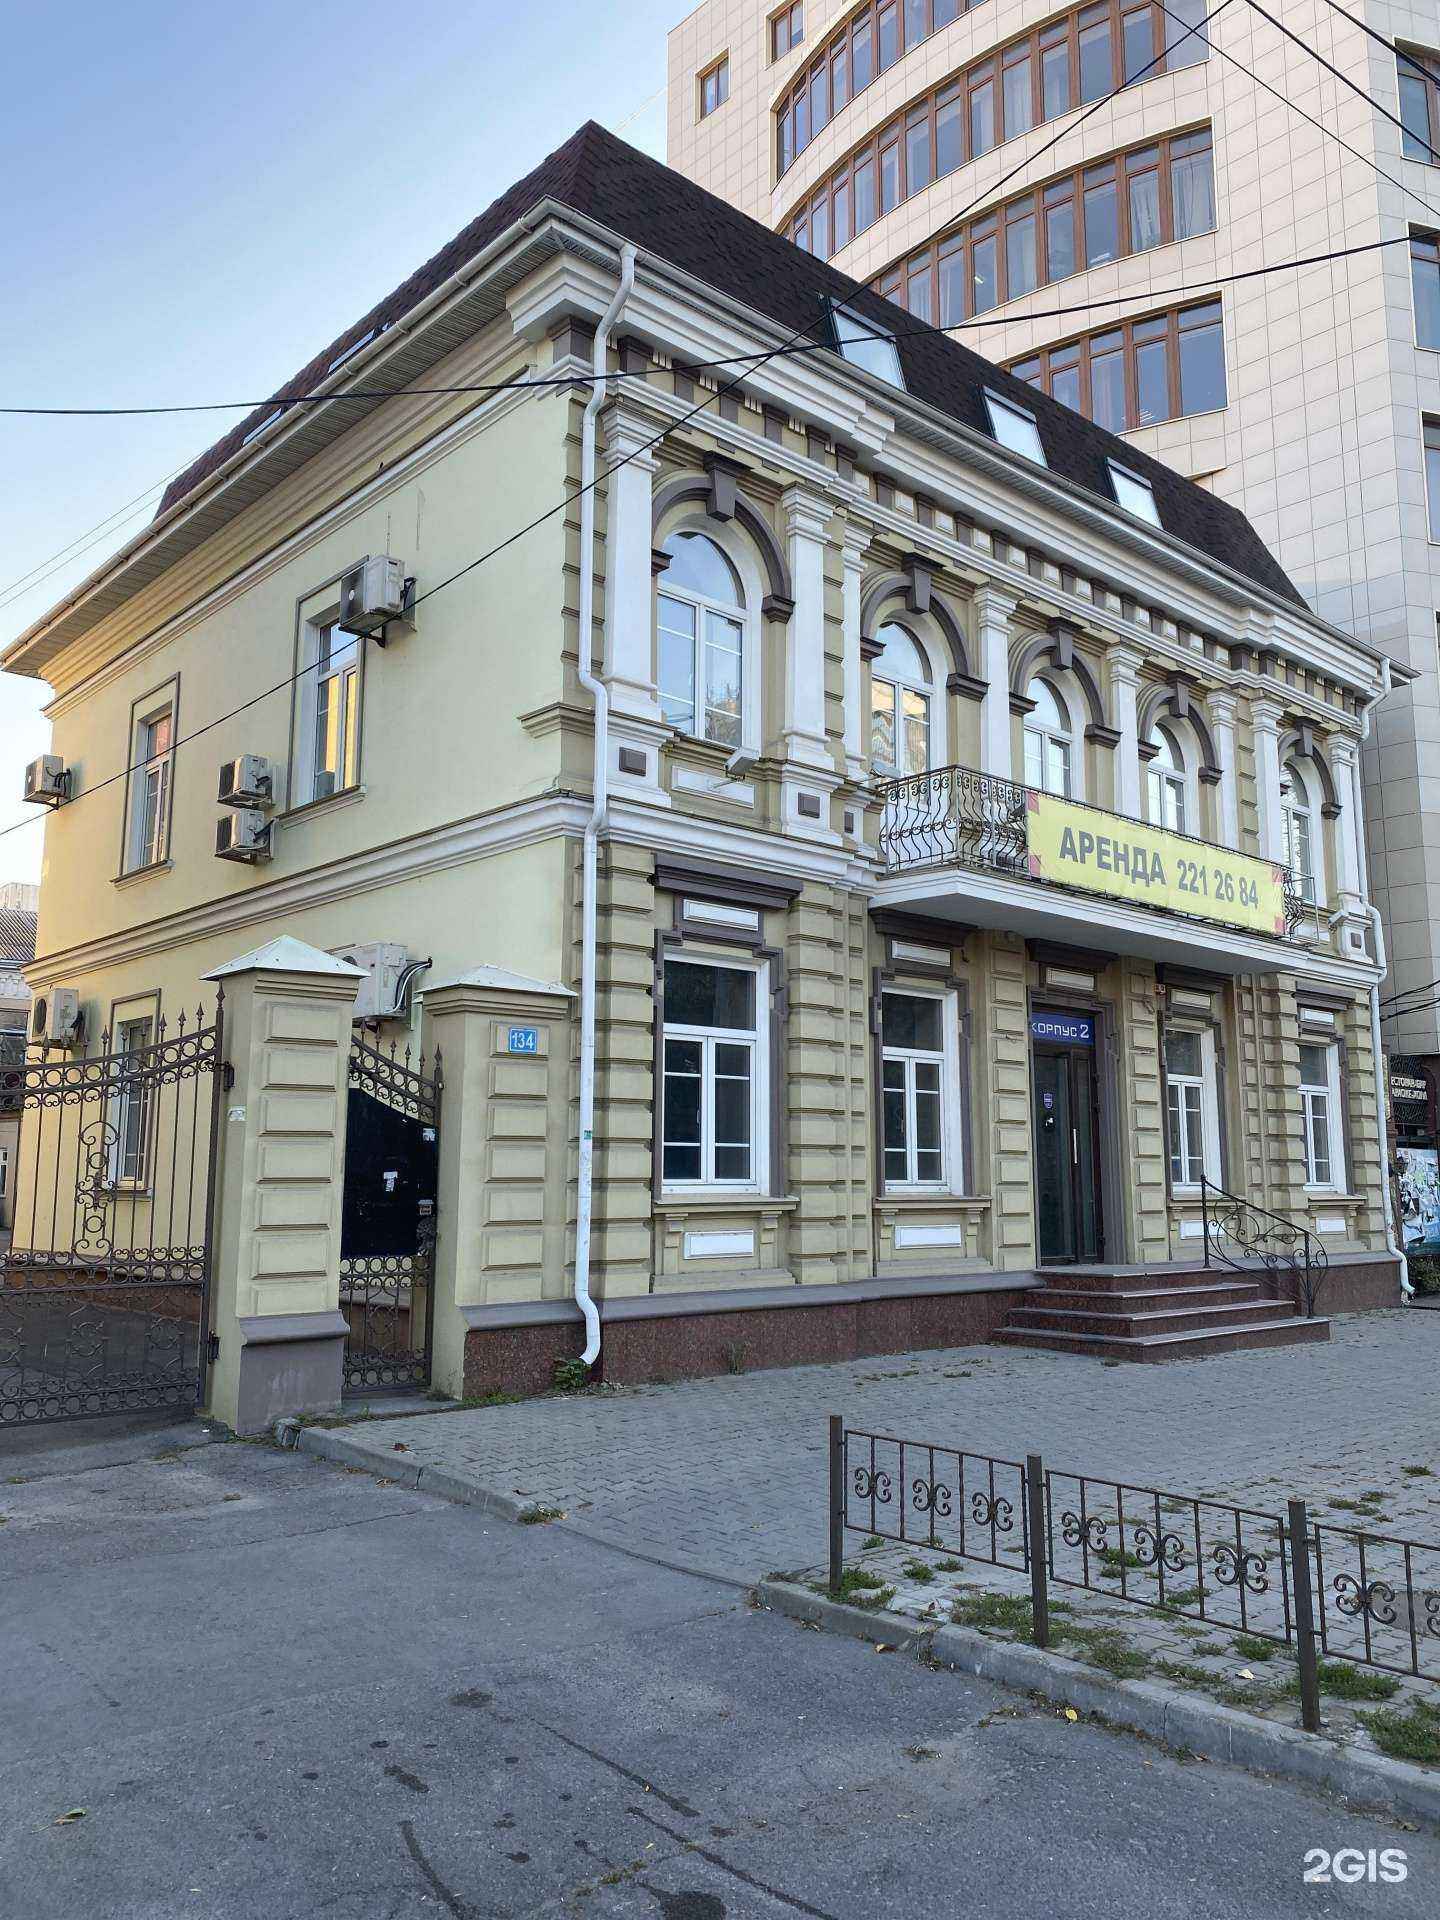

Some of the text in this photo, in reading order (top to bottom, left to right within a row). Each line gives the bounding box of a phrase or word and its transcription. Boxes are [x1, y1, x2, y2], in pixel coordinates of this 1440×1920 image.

[1059, 827, 1259, 909] АРЕНДА 221 26 84
[1080, 1024, 1089, 1038] 2
[512, 1032, 534, 1049] 134
